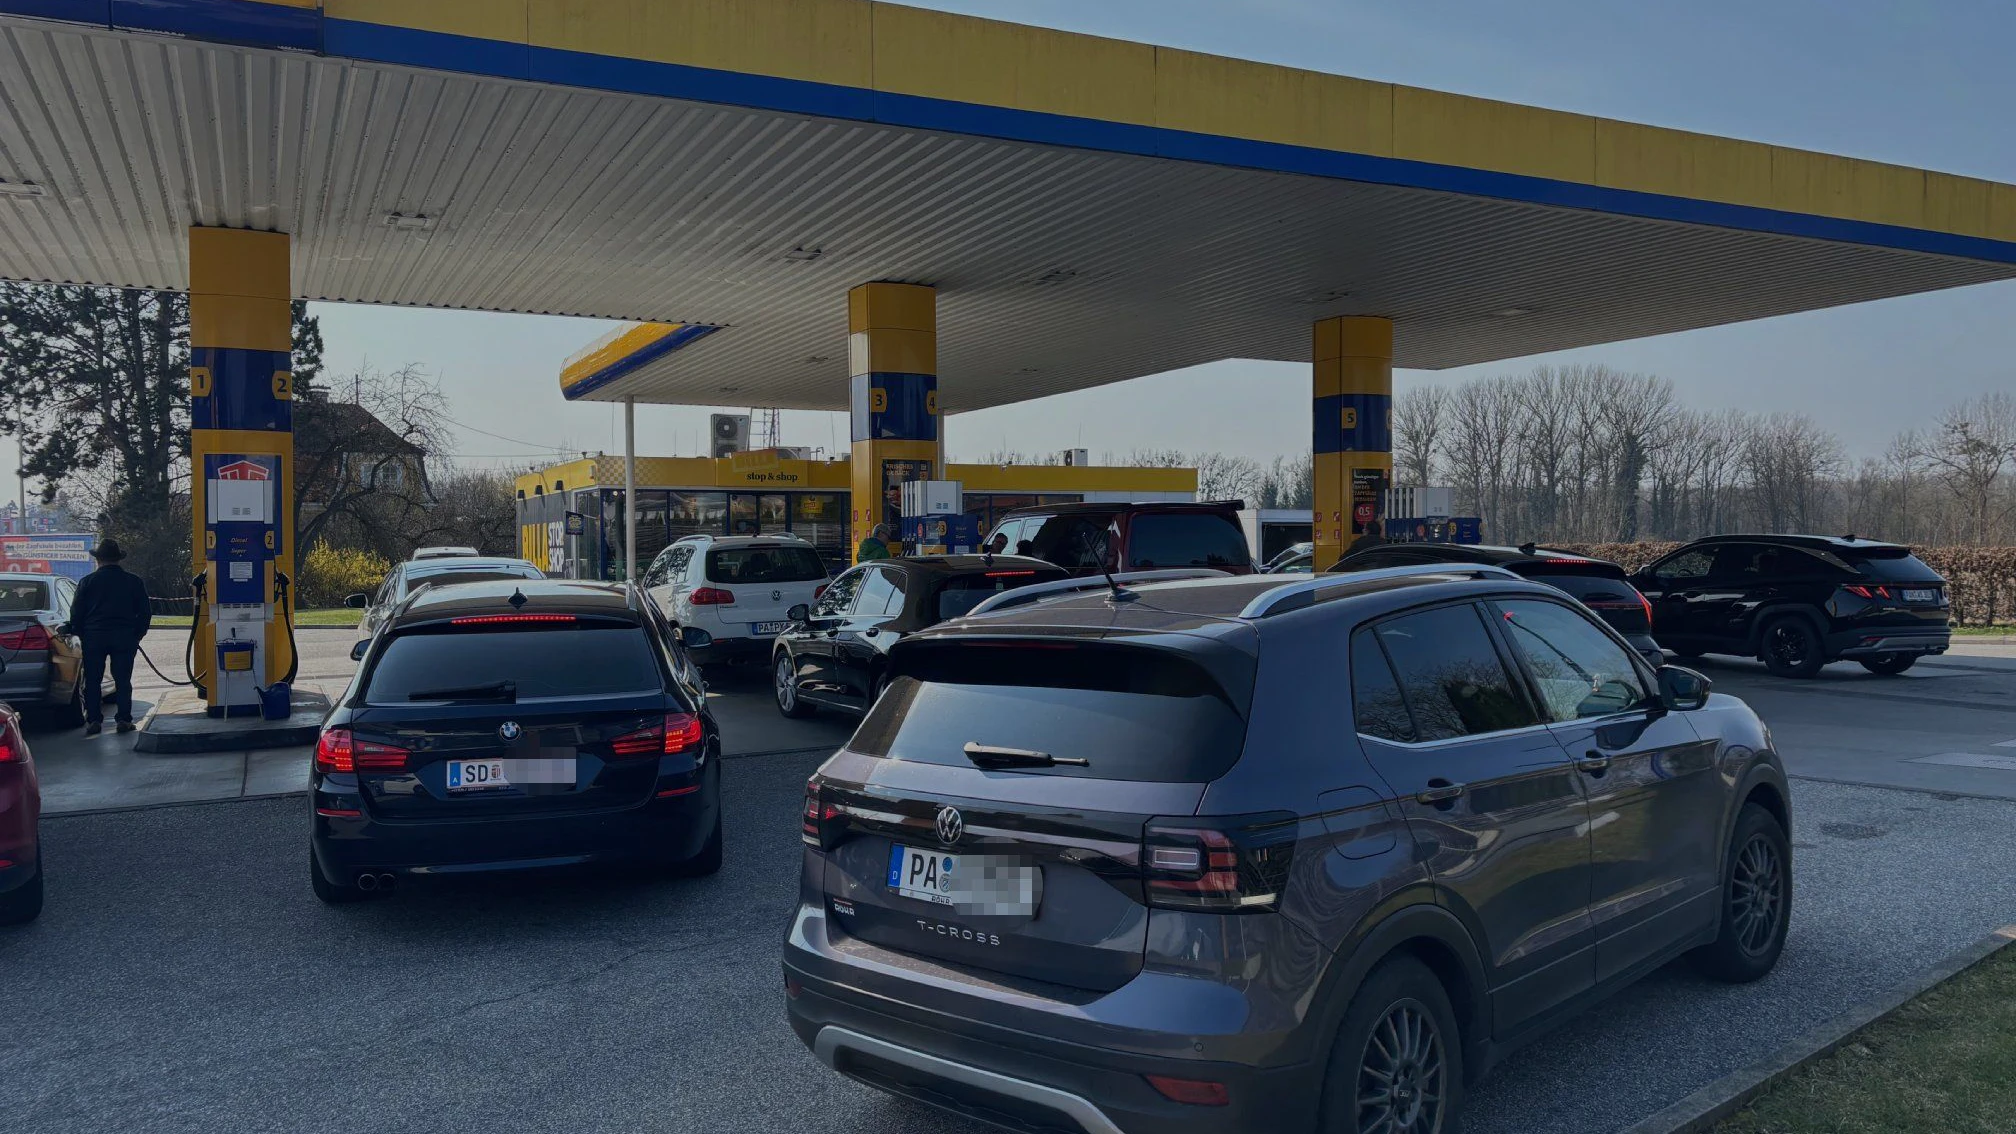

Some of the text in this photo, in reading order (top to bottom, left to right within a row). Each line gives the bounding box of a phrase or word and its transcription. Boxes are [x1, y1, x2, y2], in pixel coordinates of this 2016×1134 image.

[196, 374, 204, 389] 1
[277, 378, 288, 393] 2
[875, 394, 883, 407] 3
[929, 396, 935, 409] 4
[1347, 412, 1354, 423] 5
[746, 471, 798, 483] stop & shop
[1358, 506, 1370, 517] 0,5
[548, 521, 564, 546] STOP
[941, 524, 946, 533] 3
[209, 536, 213, 546] 1
[267, 535, 273, 545] 2
[549, 547, 564, 572] SHOP
[758, 624, 769, 632] PA
[465, 764, 489, 783] SD
[892, 853, 937, 890] D PA
[916, 919, 1001, 946] T-CROSS
